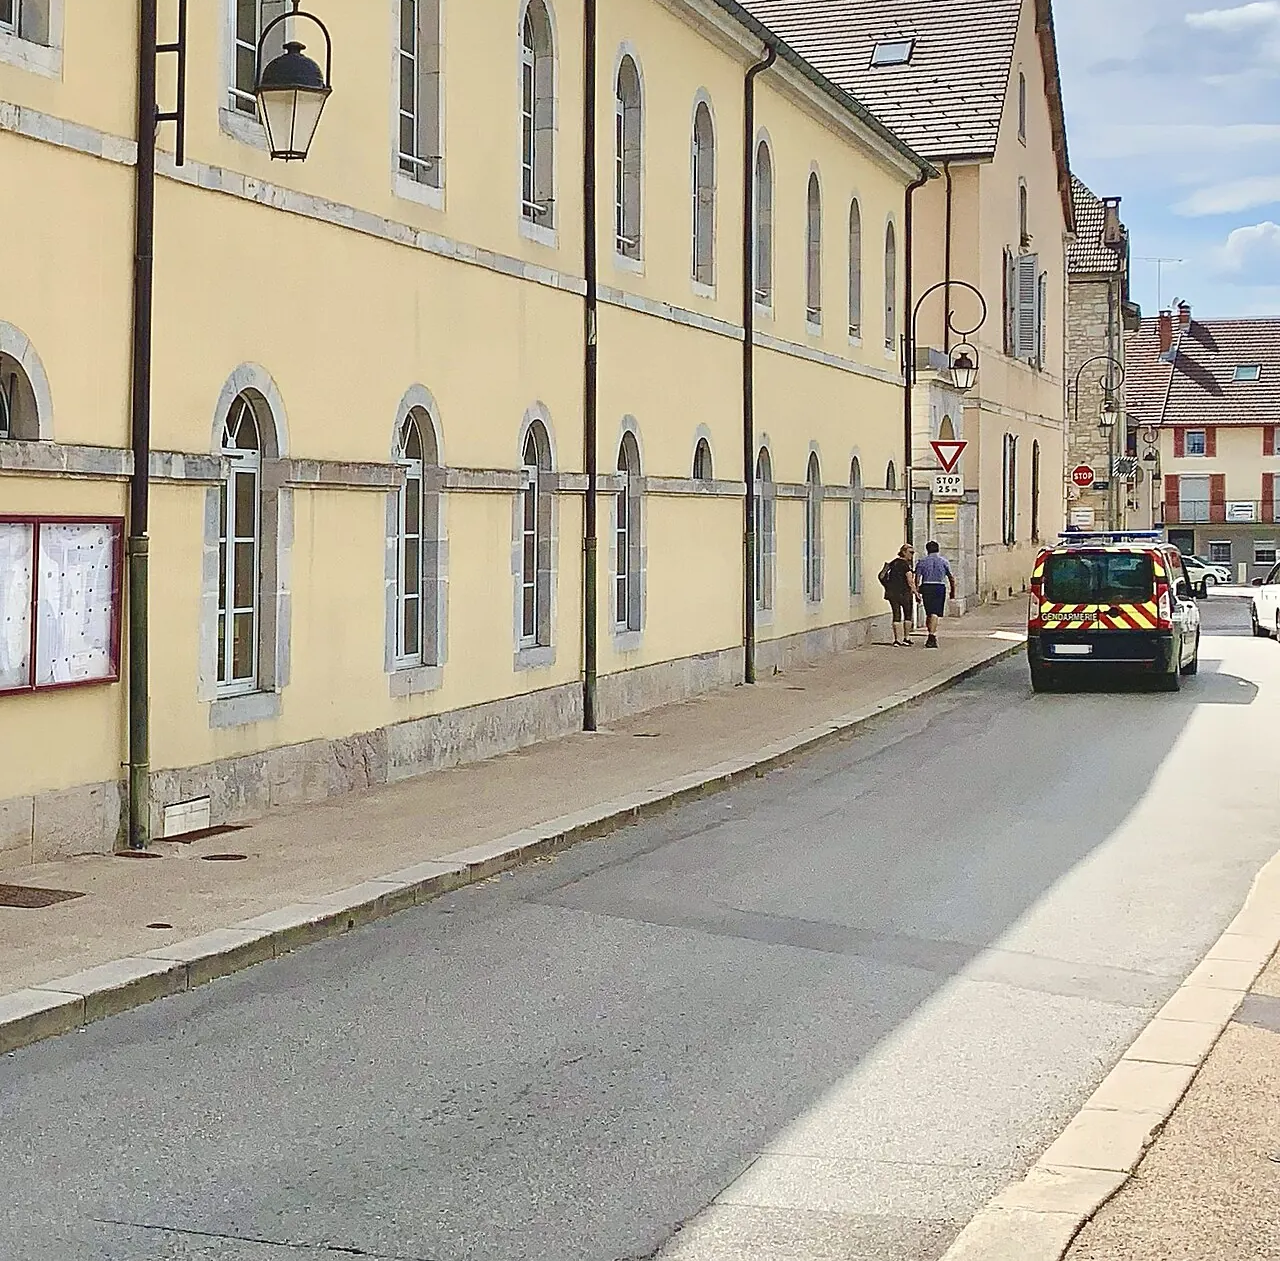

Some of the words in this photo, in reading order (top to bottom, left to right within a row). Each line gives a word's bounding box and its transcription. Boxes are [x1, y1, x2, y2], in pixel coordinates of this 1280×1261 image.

[1073, 472, 1093, 480] STOP
[936, 477, 960, 485] STOP
[938, 485, 950, 493] 25
[1041, 613, 1098, 621] GENDARMERIE
